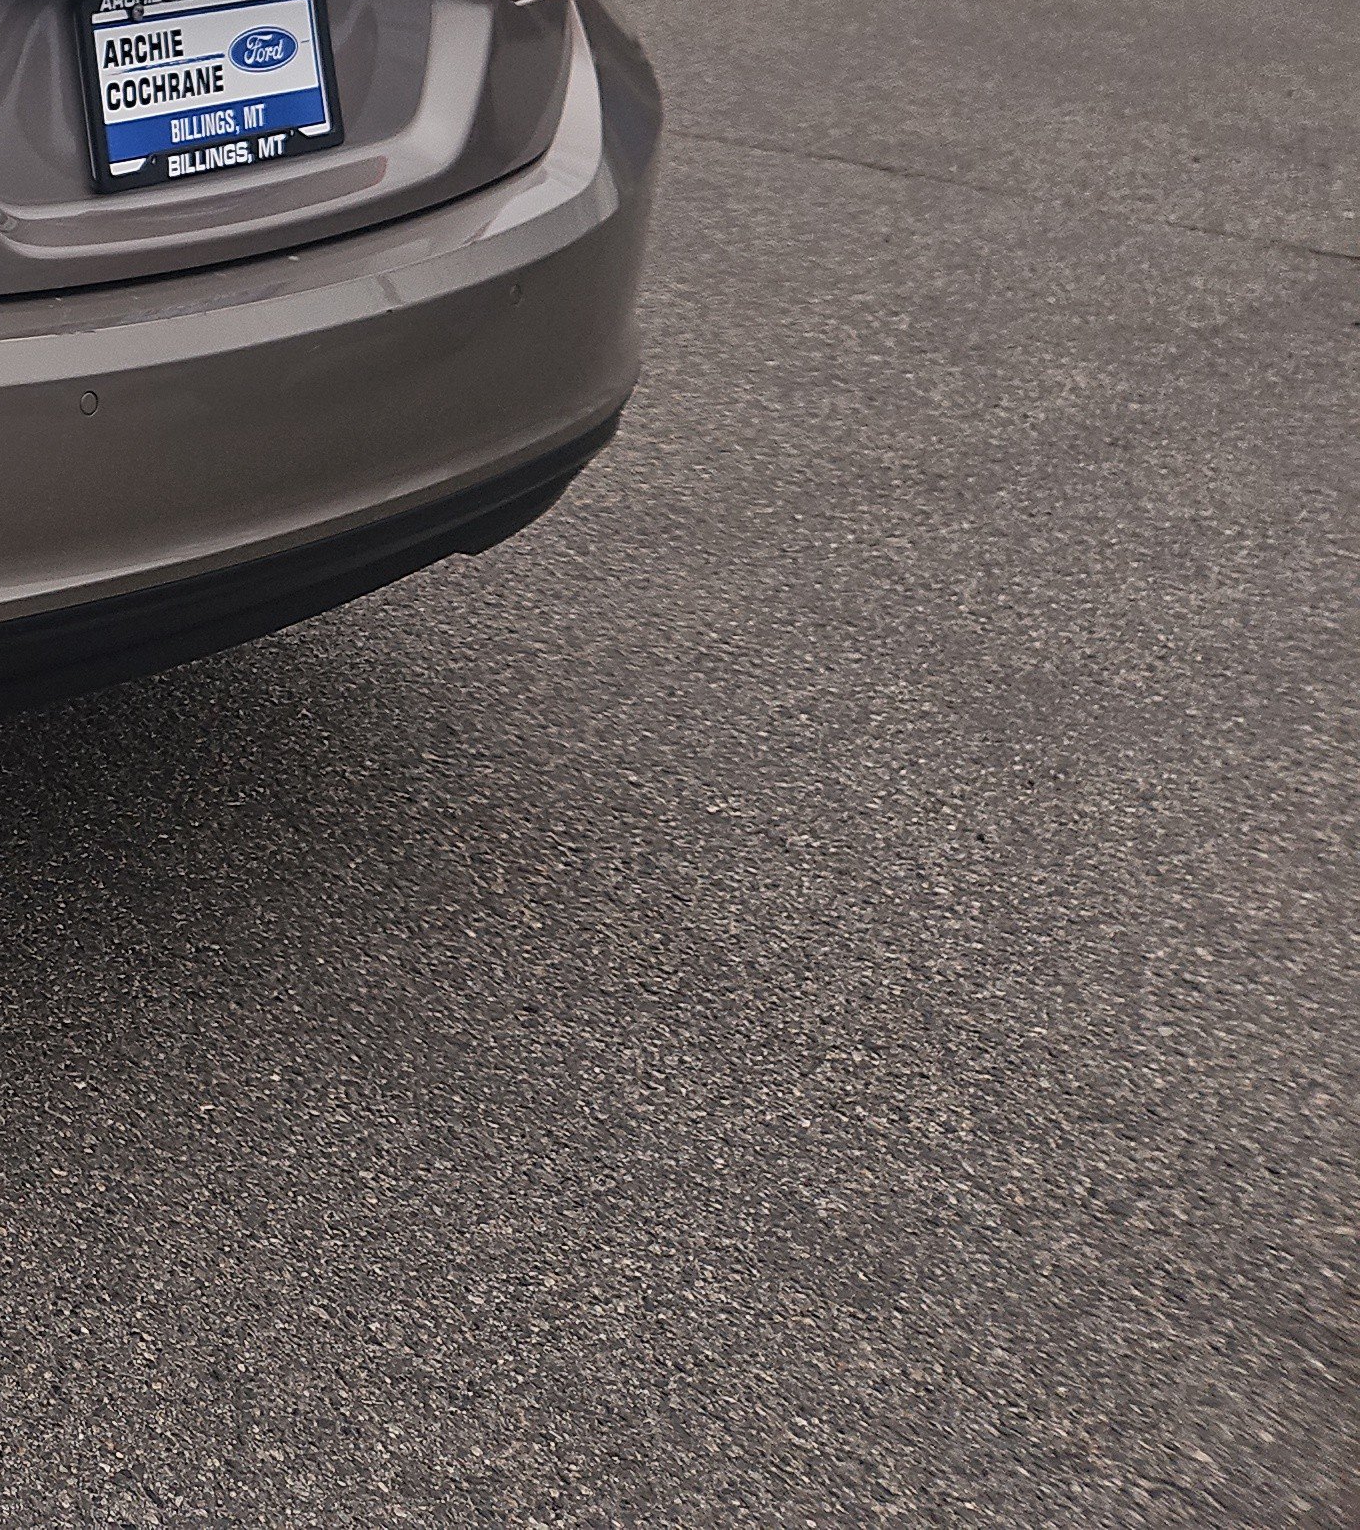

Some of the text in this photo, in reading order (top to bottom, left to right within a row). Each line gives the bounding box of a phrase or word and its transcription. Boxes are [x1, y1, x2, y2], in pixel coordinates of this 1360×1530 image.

[103, 29, 184, 69] ARCHIE
[243, 34, 284, 64] Ford
[106, 64, 224, 111] COCHRANE
[170, 103, 265, 144] BILLINGS, MT
[168, 133, 287, 178] BILLINGS, MT
